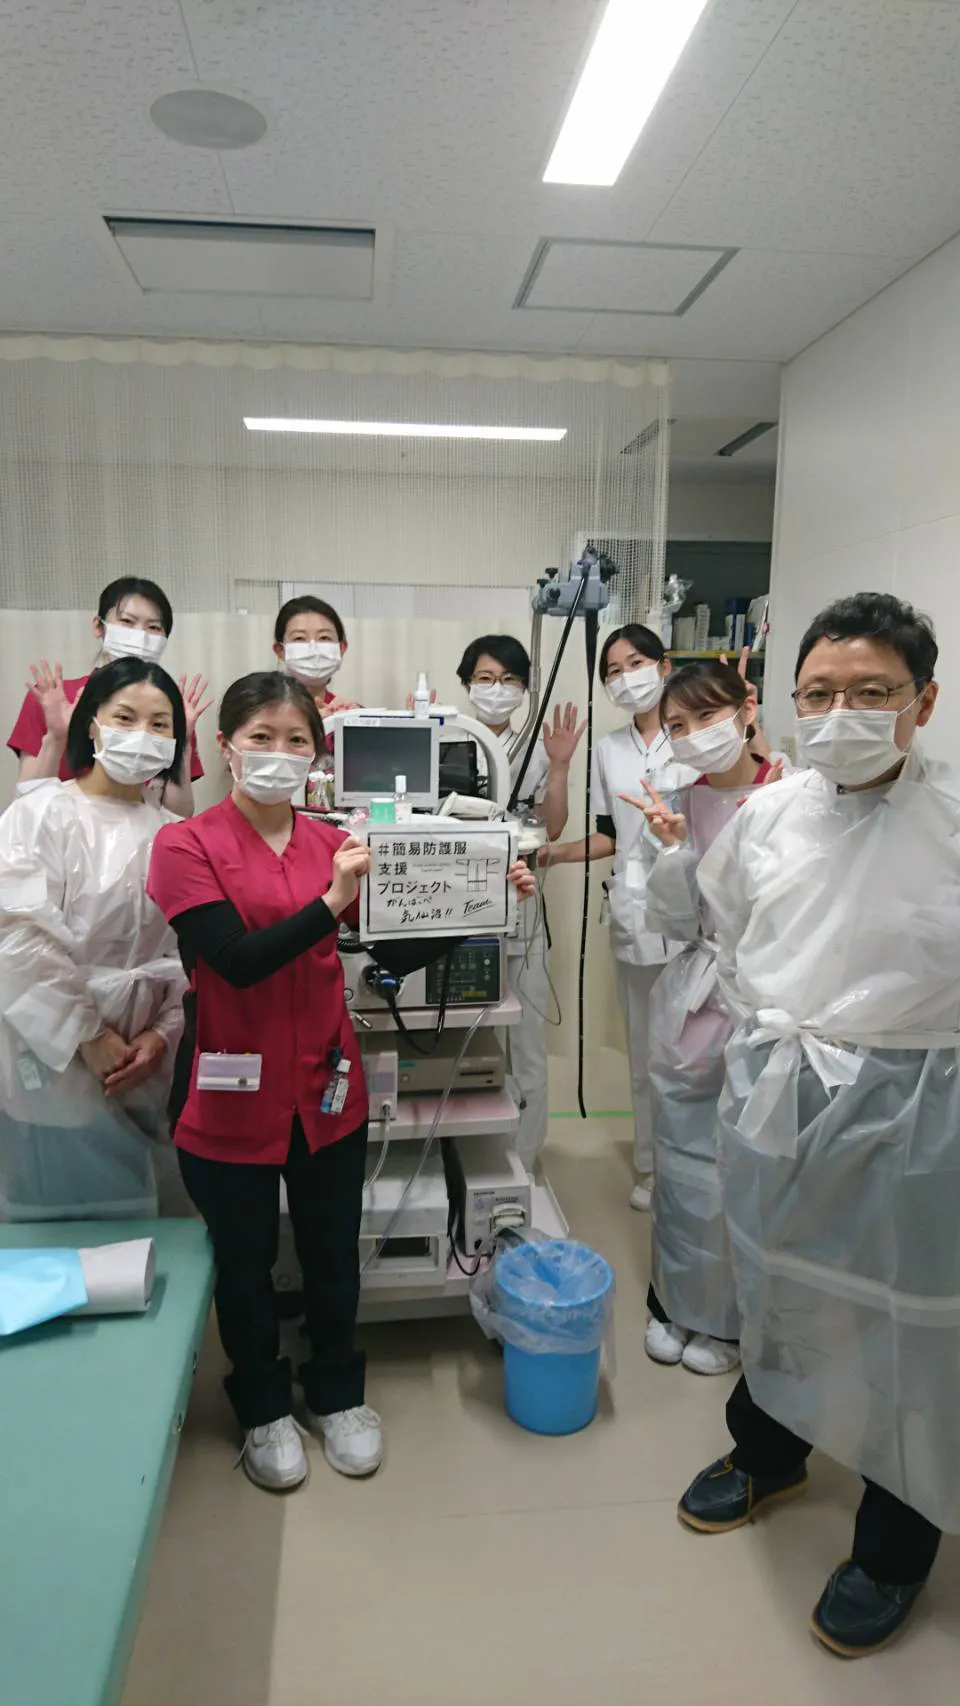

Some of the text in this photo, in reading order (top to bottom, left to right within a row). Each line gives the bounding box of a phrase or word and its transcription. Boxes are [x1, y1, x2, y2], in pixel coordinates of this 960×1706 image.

[378, 841, 467, 857] #簡易防護服
[378, 862, 408, 876] 支援
[377, 880, 452, 895] プロジェクト
